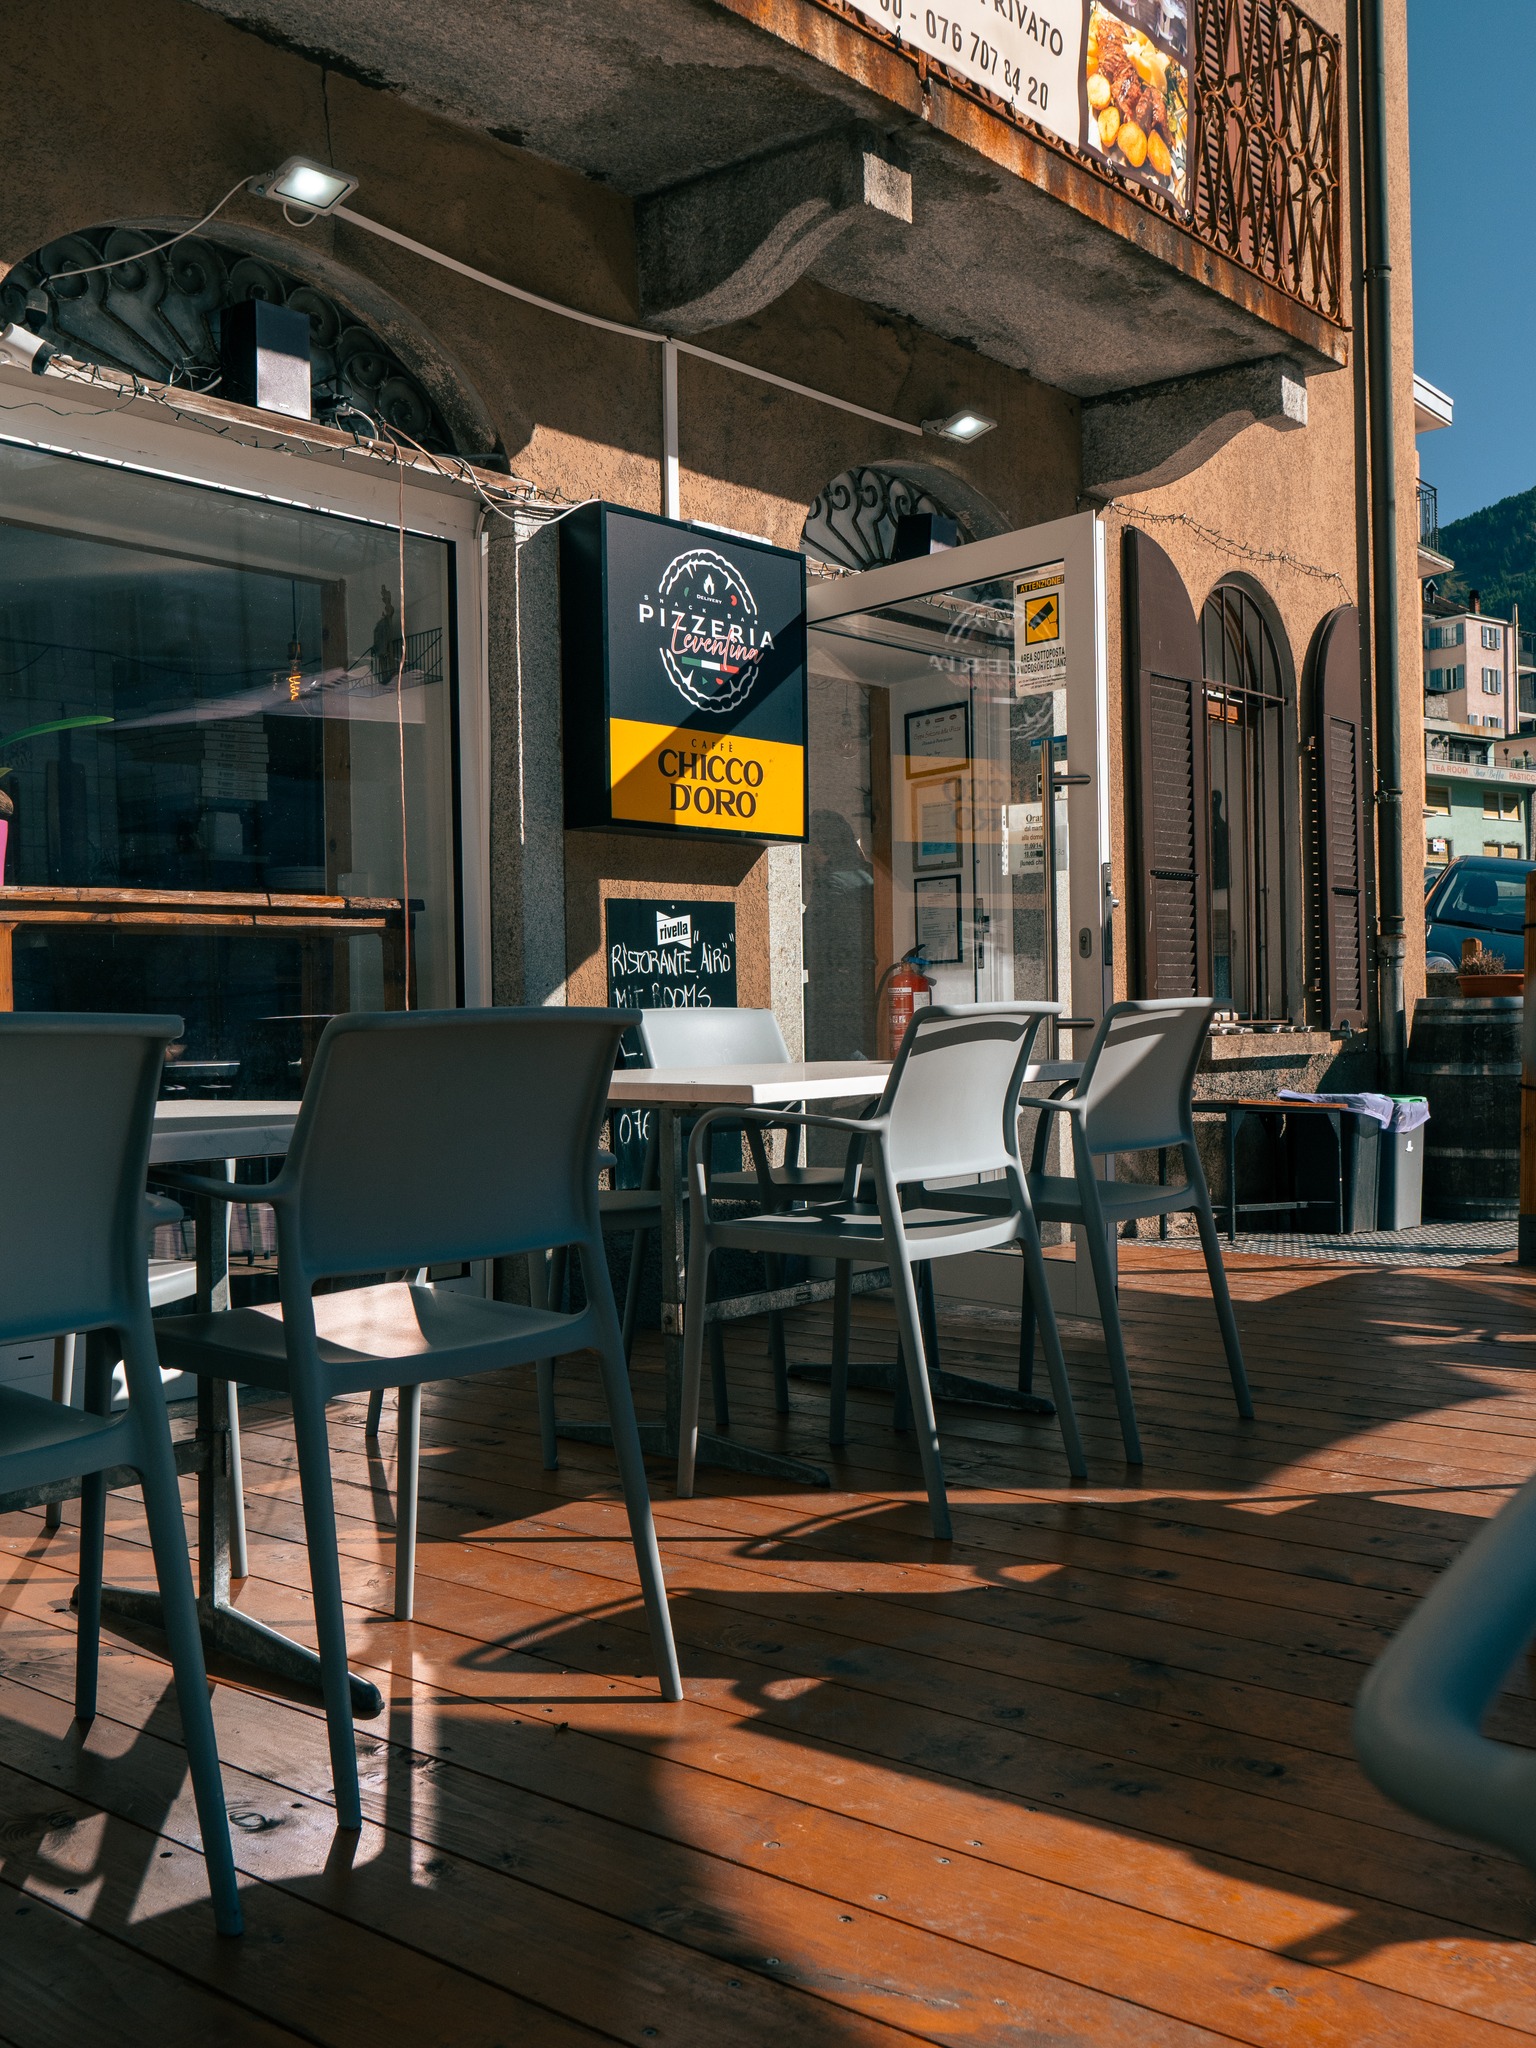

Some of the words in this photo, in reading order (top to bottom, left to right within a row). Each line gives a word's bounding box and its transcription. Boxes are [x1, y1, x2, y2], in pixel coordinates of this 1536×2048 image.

[980, 0, 1064, 57] RIVATO
[926, 9, 962, 52] 076
[970, 32, 998, 76] 707
[1004, 59, 1021, 95] 84
[1027, 76, 1049, 111] 20
[1019, 575, 1064, 593] ATTENZIONE!
[643, 594, 707, 614] SNACK
[726, 613, 759, 625] BAR
[696, 594, 722, 605] DELIVERY
[639, 603, 775, 651] PIZZERIA
[671, 615, 765, 671] Leventina
[1020, 653, 1033, 664] AREA
[1033, 646, 1065, 662] SOTTOPOSTA
[1020, 656, 1066, 675] VIDEOSORVEGLIANZ
[691, 738, 733, 753] CAFFÈ
[657, 748, 764, 788] CHICCO
[1432, 764, 1445, 773] TEA
[1447, 766, 1468, 775] ROOM
[1509, 772, 1536, 781] PASTICC
[669, 782, 757, 819] D'ORO
[1025, 814, 1043, 824] Orar
[659, 921, 689, 940] rivella
[611, 942, 697, 977] RISTORANTE
[651, 982, 712, 1008] ROOMS
